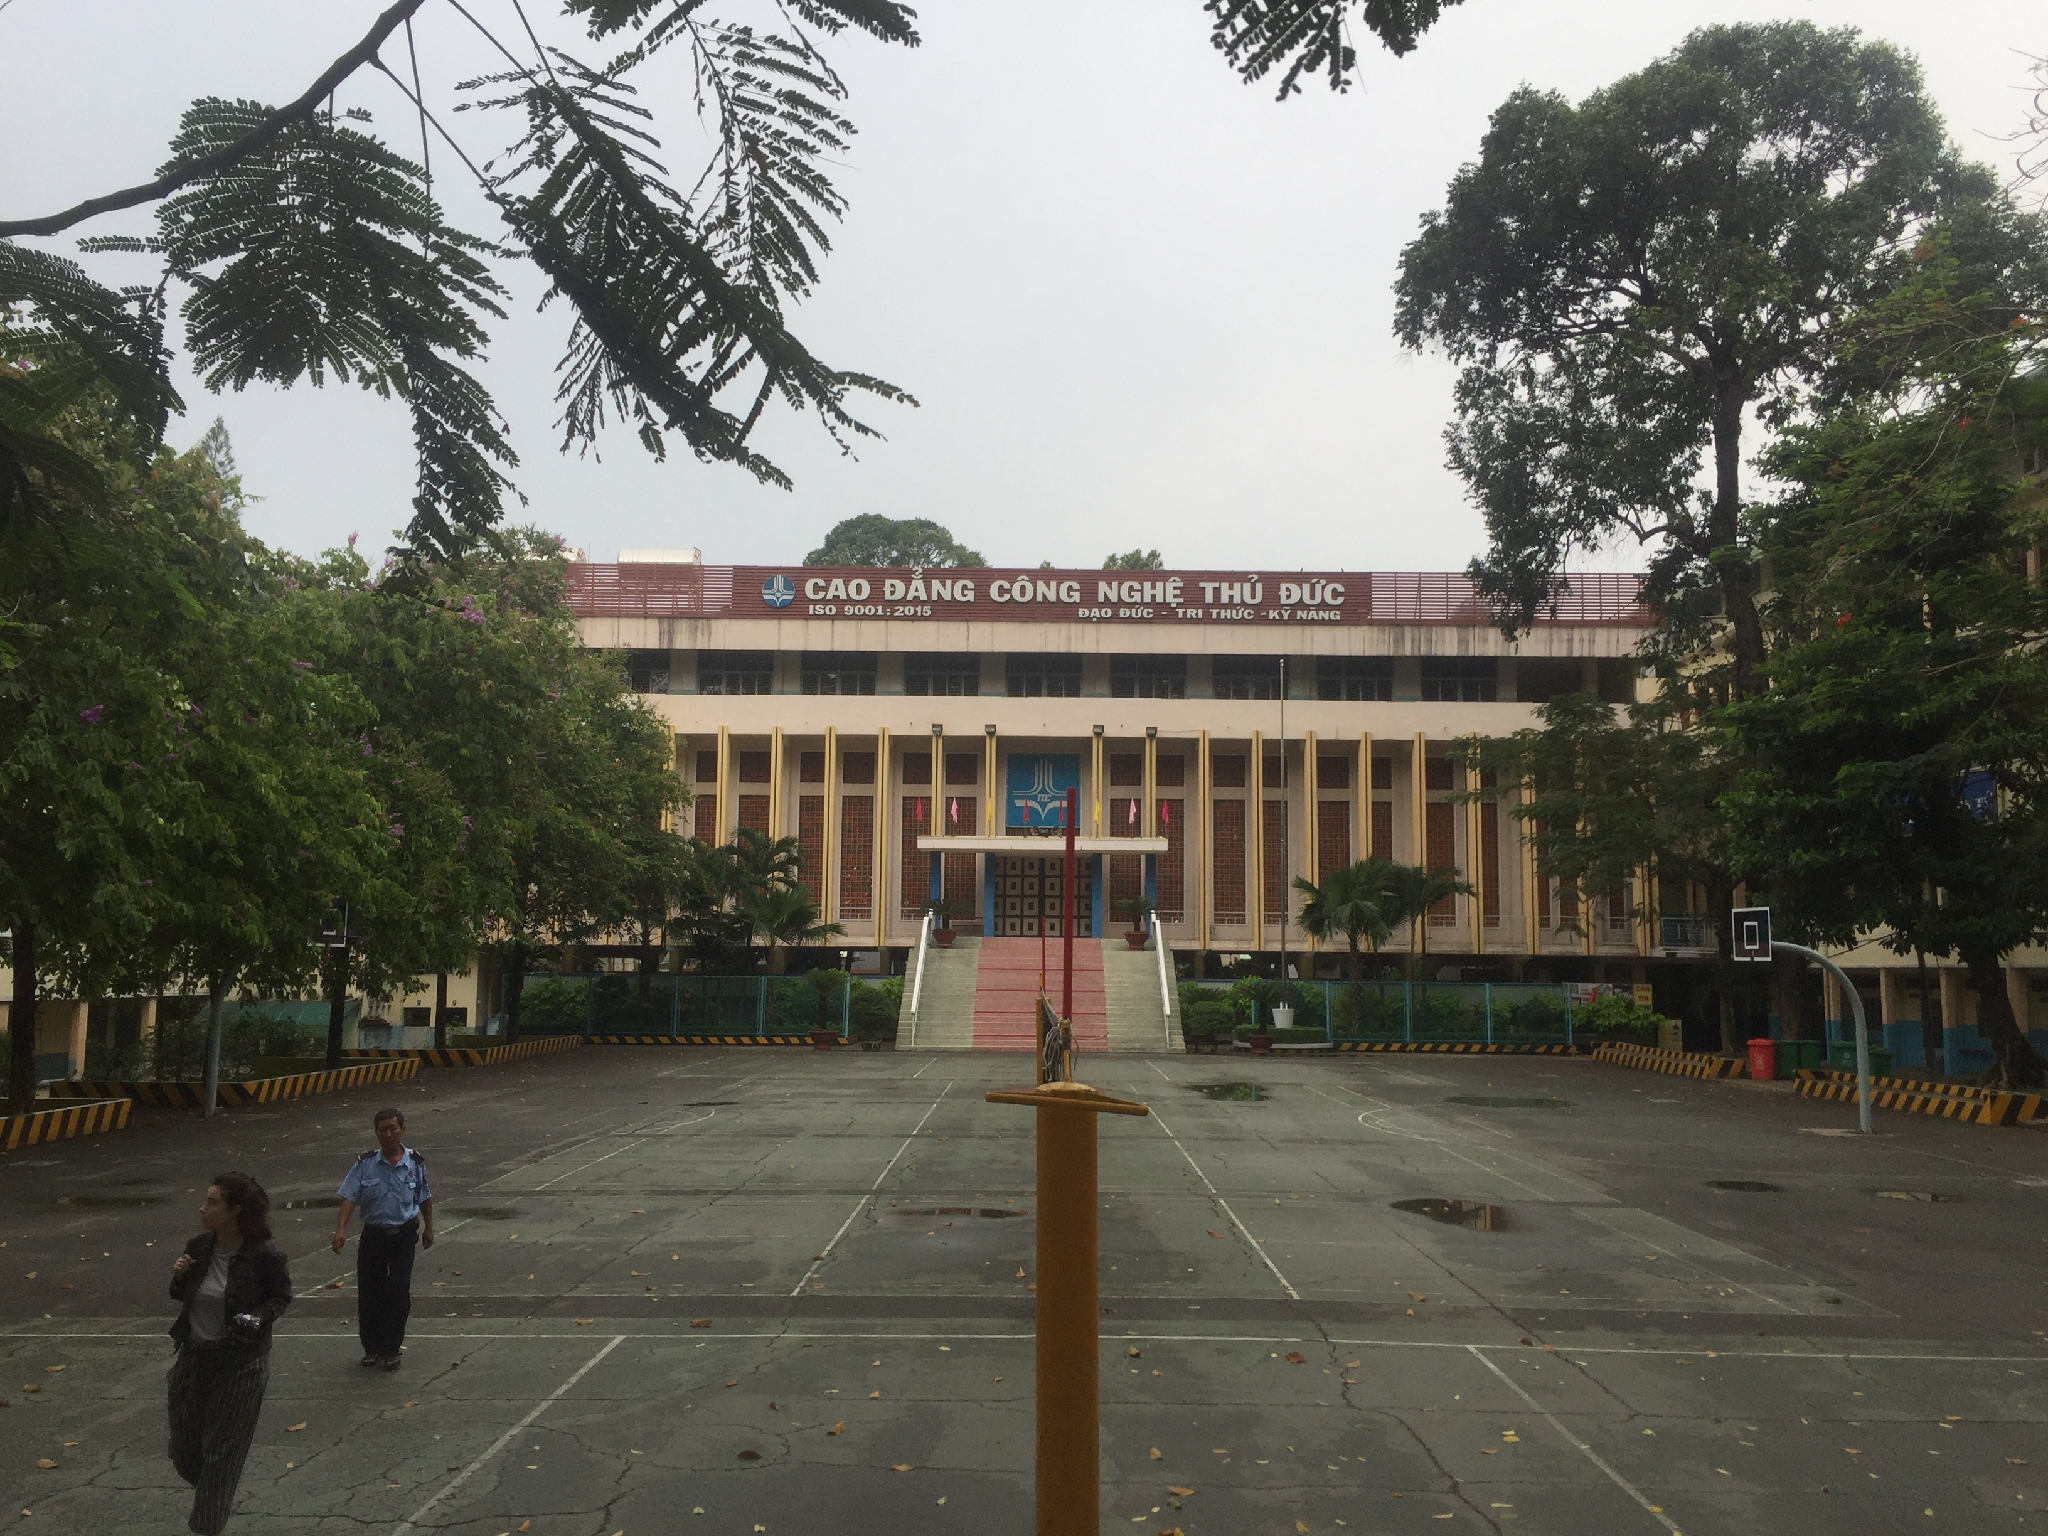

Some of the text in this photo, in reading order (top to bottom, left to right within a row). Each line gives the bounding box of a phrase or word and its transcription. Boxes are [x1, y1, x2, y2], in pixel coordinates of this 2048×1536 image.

[804, 566, 1345, 607] CAO ĐẲNG CÔNG NGHỆ THỦ ĐỨC
[808, 604, 837, 615] ISO
[1077, 607, 1113, 622] ĐẠO
[1118, 605, 1154, 619] ĐỨC
[1175, 608, 1203, 619] TRI
[1209, 606, 1255, 620] THỨC
